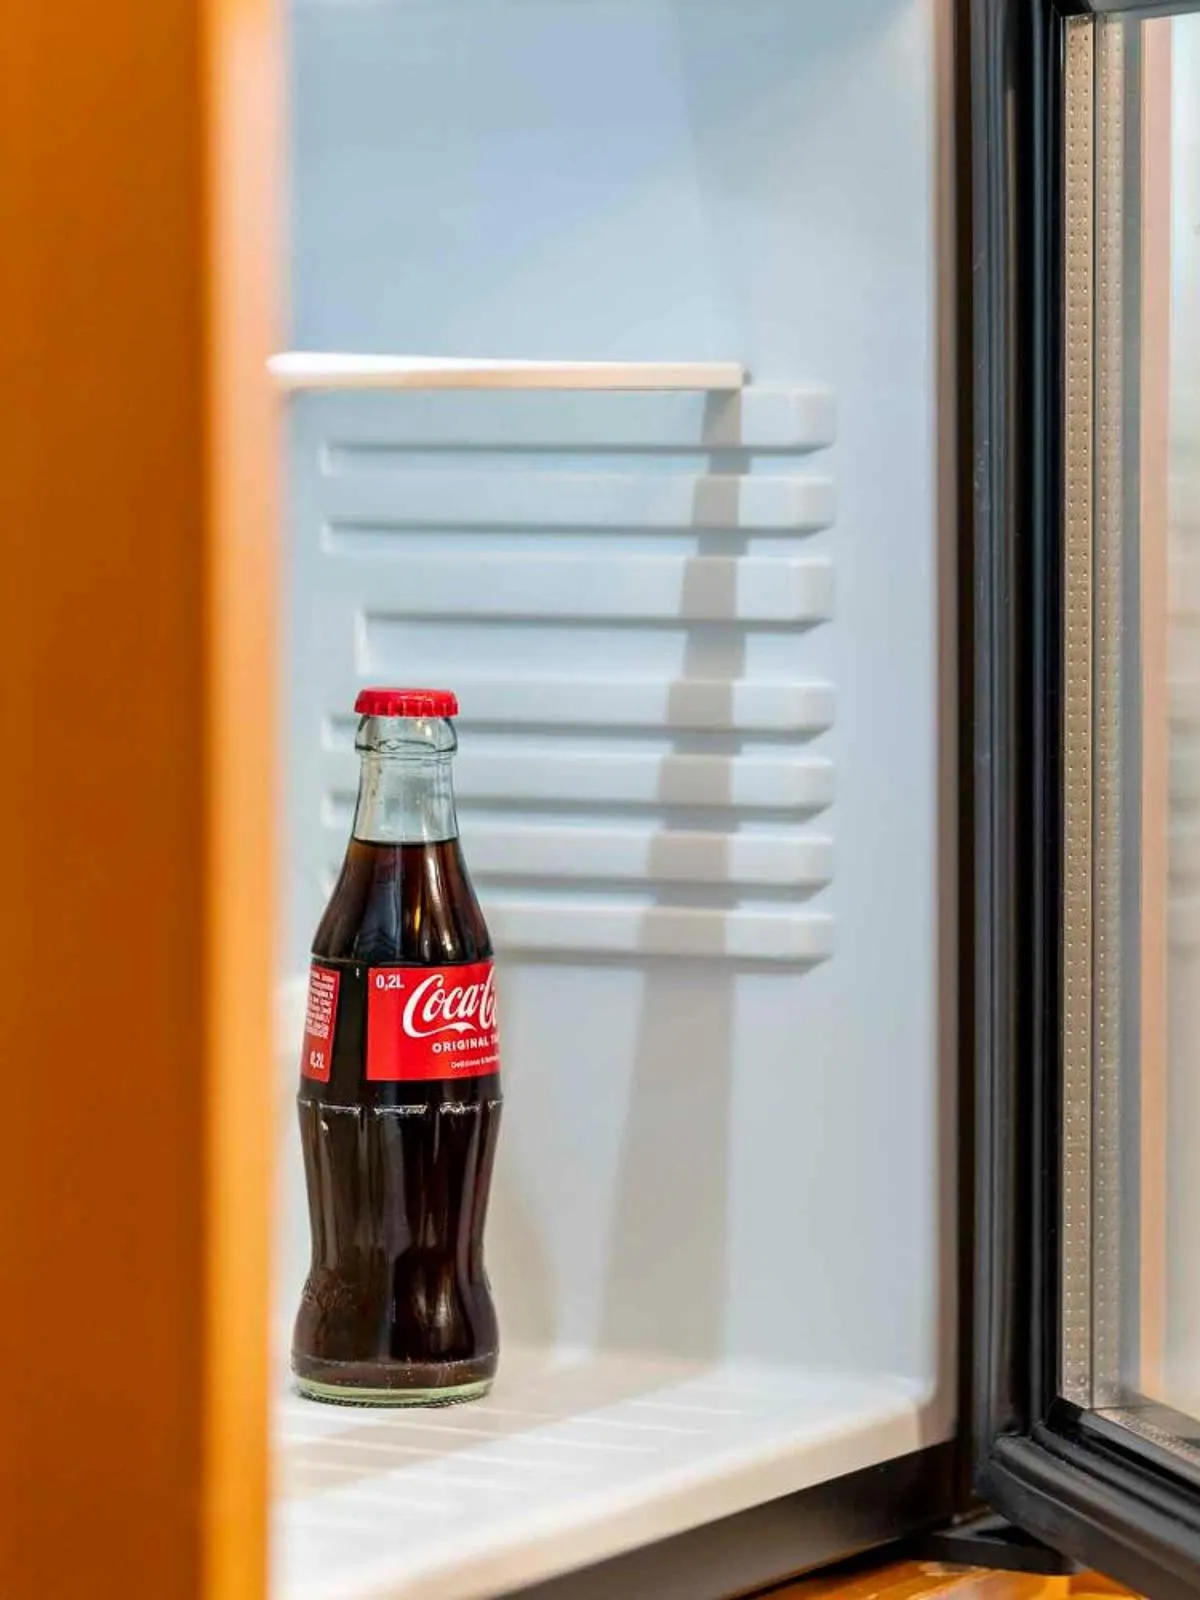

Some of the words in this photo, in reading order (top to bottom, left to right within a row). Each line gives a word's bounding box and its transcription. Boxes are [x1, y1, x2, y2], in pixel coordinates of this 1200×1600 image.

[375, 974, 405, 990] 0,2L
[402, 965, 498, 1038] Coca-C
[432, 1036, 490, 1054] ORIGINAL
